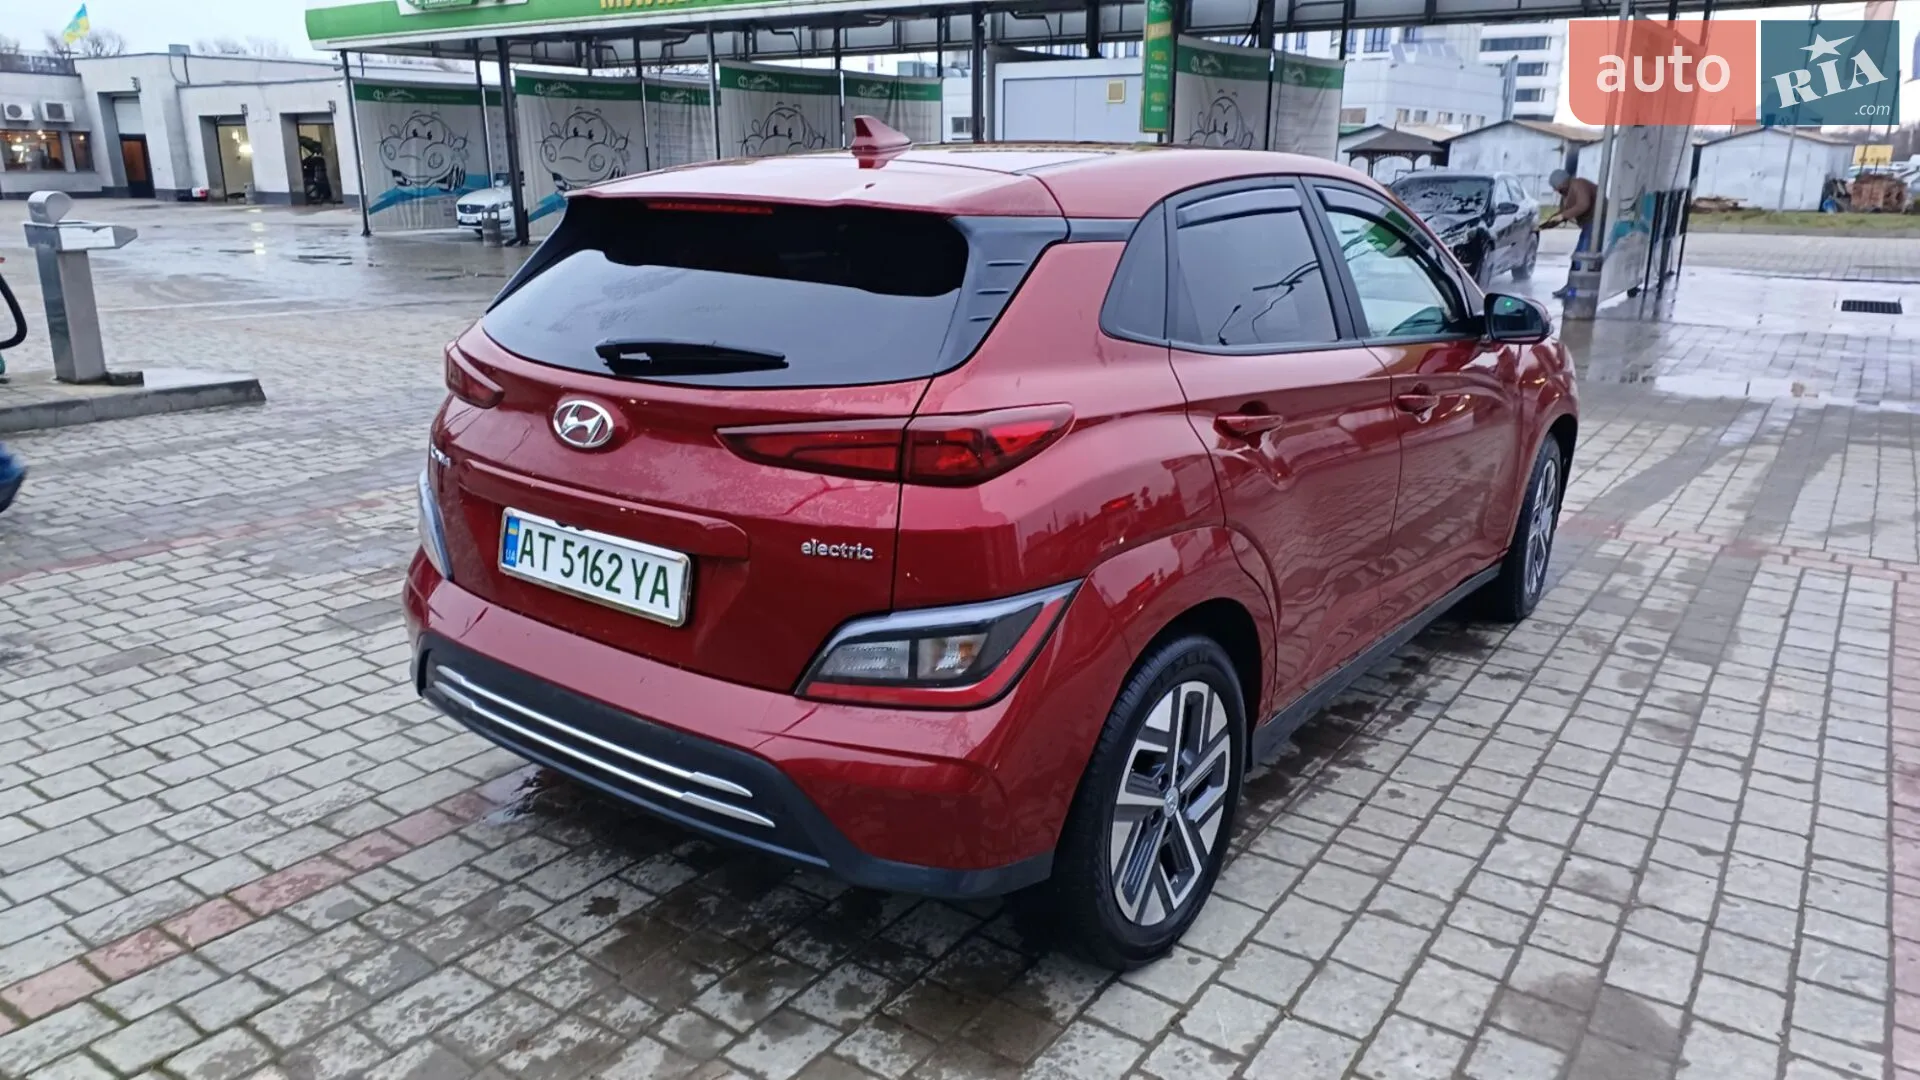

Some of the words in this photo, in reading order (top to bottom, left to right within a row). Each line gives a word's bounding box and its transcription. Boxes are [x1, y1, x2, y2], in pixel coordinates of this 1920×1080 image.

[505, 548, 516, 563] UA
[801, 538, 874, 560] electric
[518, 528, 556, 572] AT
[560, 538, 623, 595] 5162
[631, 557, 671, 609] YA
